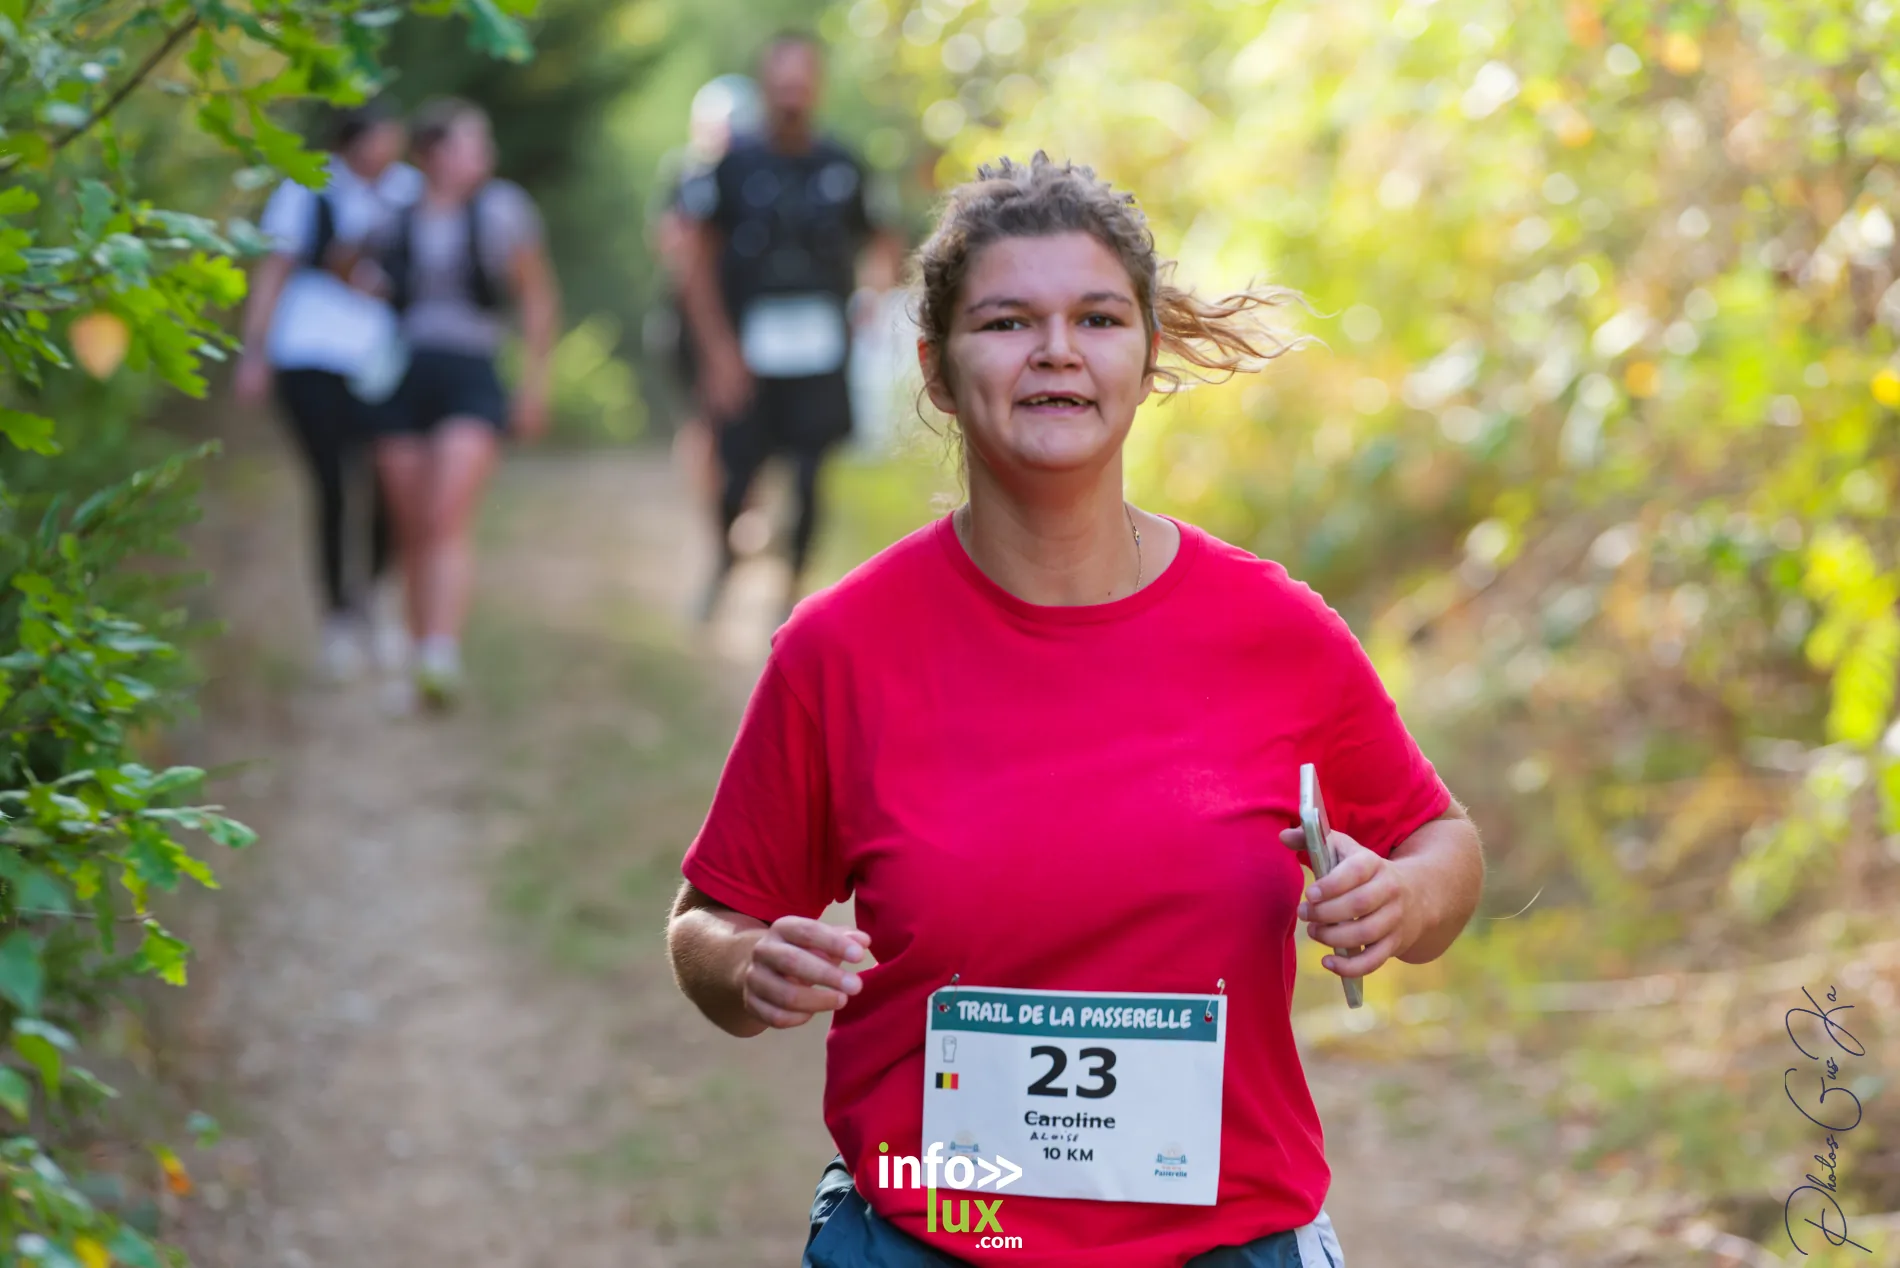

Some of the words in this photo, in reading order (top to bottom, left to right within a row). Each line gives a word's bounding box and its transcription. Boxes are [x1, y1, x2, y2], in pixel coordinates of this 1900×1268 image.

[957, 1000, 1013, 1022] TRAIL
[1018, 1005, 1044, 1024] DE
[1049, 1006, 1075, 1027] LA
[1080, 1007, 1192, 1029] PASSERELLE
[1027, 1045, 1118, 1099] 23
[1024, 1110, 1116, 1129] Caroline
[1043, 1147, 1061, 1160] 10
[1067, 1148, 1094, 1161] KM
